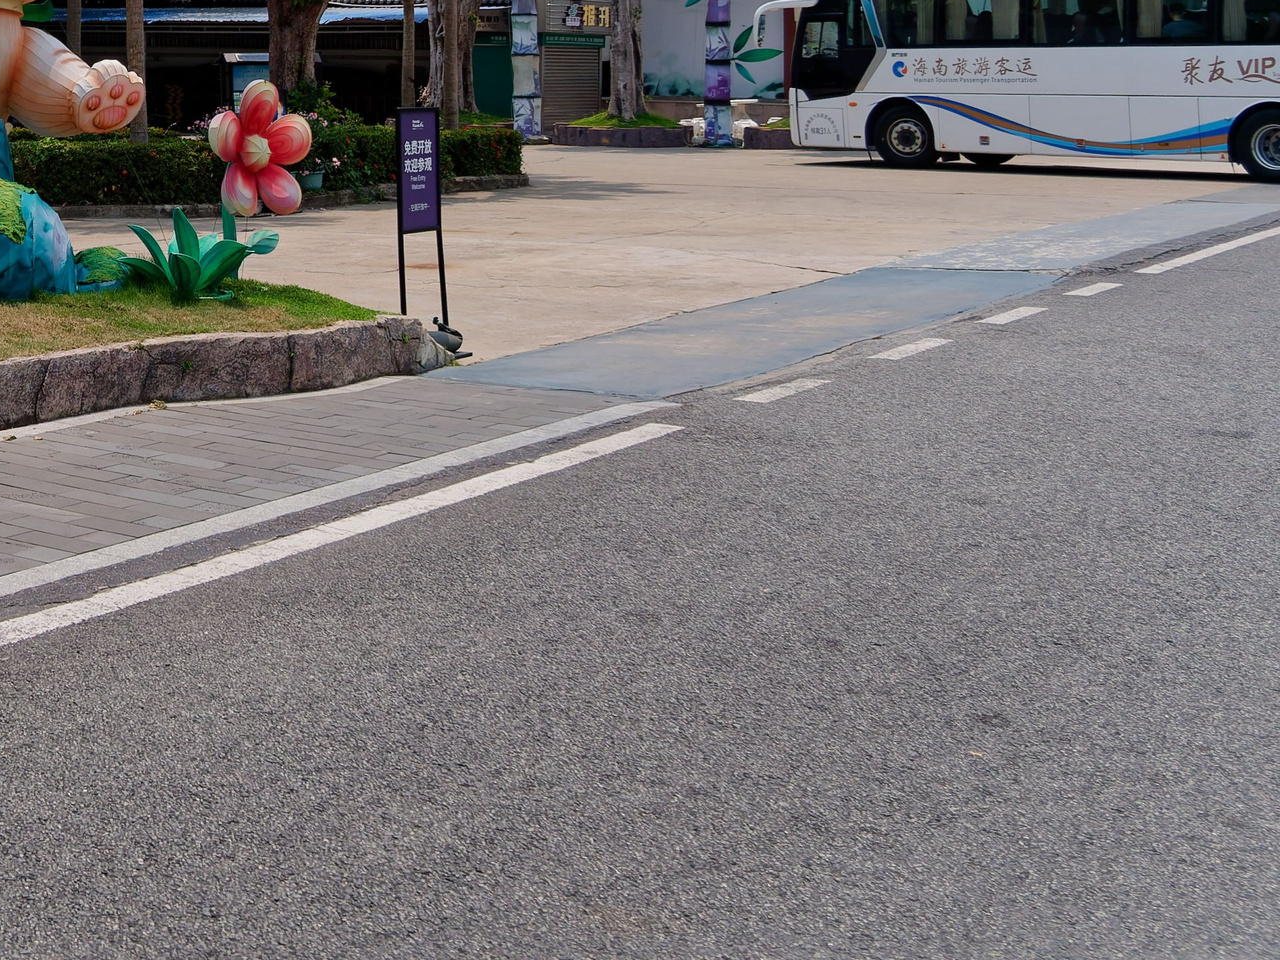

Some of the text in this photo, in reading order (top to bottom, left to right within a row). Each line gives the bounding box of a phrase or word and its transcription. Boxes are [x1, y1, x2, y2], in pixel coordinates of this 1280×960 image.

[912, 56, 1038, 77] 海南旅游客运
[1180, 55, 1276, 86] 聚友 VIP
[404, 139, 432, 155] 免费开放
[404, 157, 432, 173] 欢迎参观
